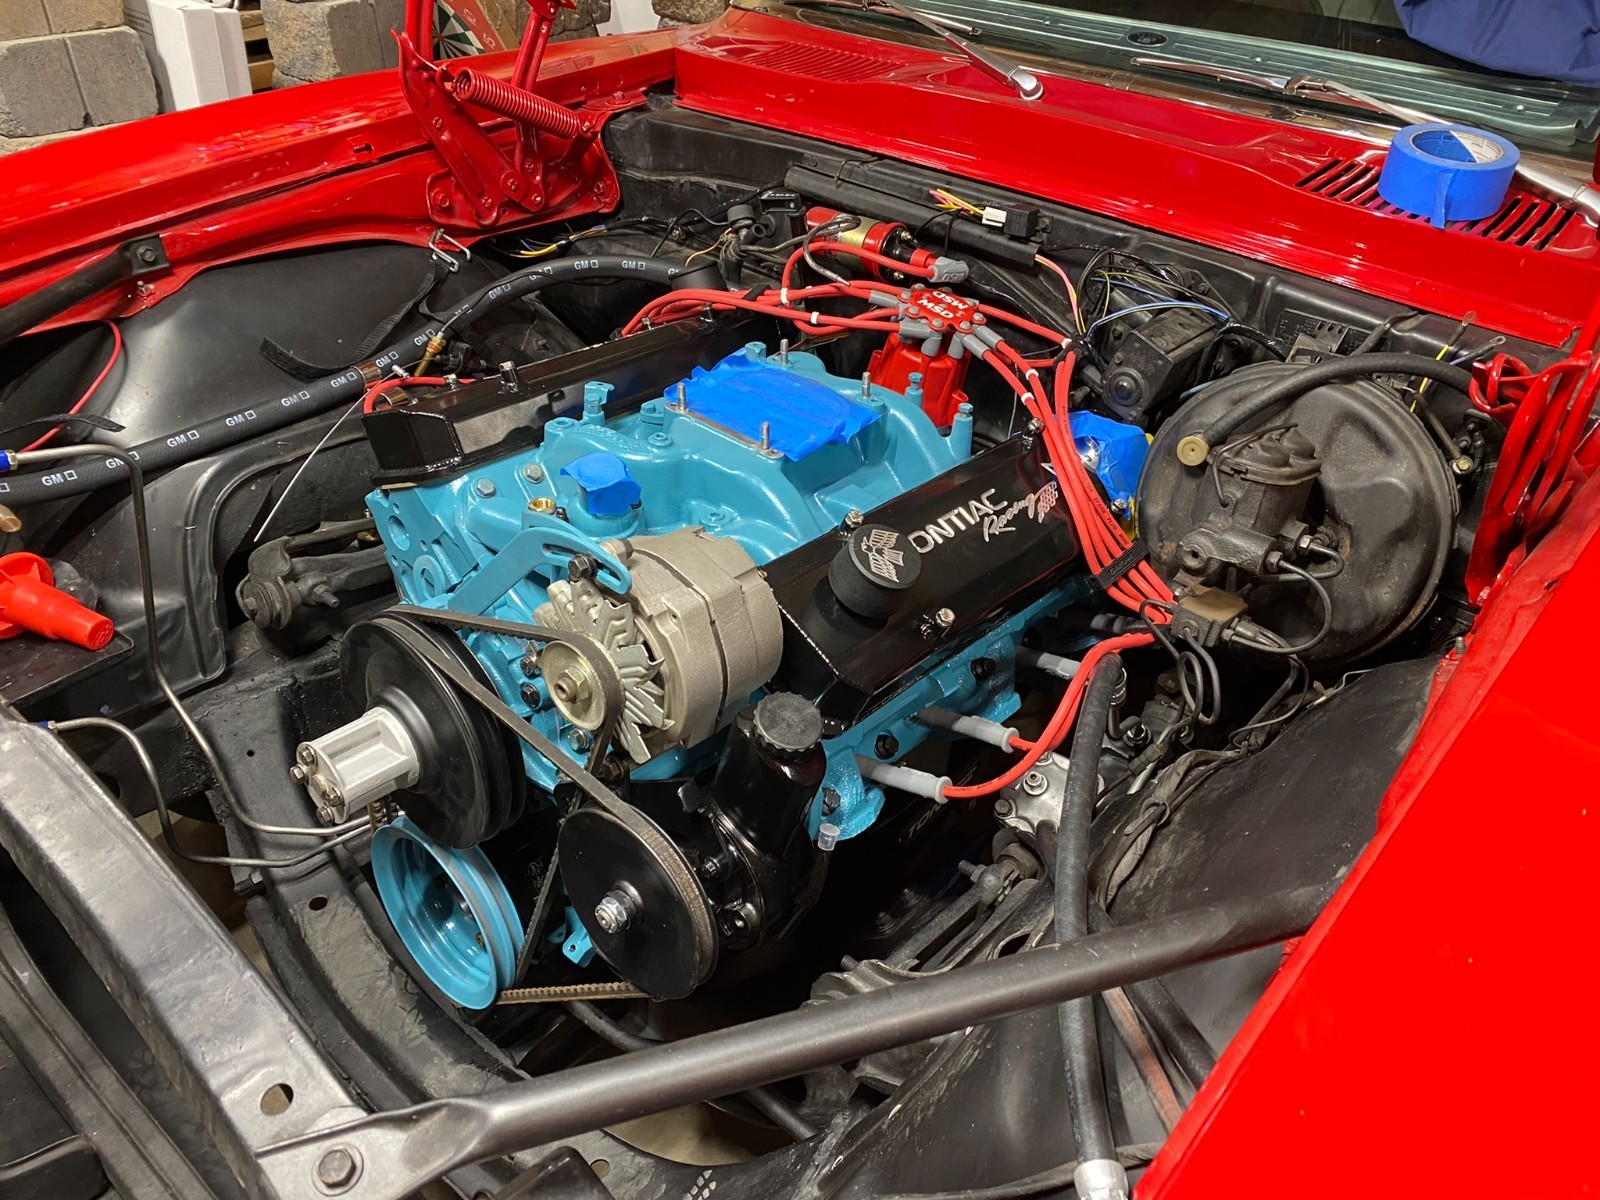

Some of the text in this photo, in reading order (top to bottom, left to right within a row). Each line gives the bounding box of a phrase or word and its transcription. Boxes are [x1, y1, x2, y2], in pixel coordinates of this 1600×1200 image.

[574, 260, 589, 270] GM
[621, 260, 636, 270] GM
[488, 285, 503, 300] GM
[932, 290, 969, 309] MSD
[917, 299, 954, 318] MSD
[414, 334, 429, 347] GM
[375, 355, 391, 368] GM
[330, 375, 348, 388] GM
[281, 394, 300, 407] GM
[225, 413, 244, 427] GM
[166, 434, 187, 448] GM
[41, 472, 64, 486] GM
[907, 488, 1008, 553] ONTIAC
[983, 492, 1036, 542] Racing
